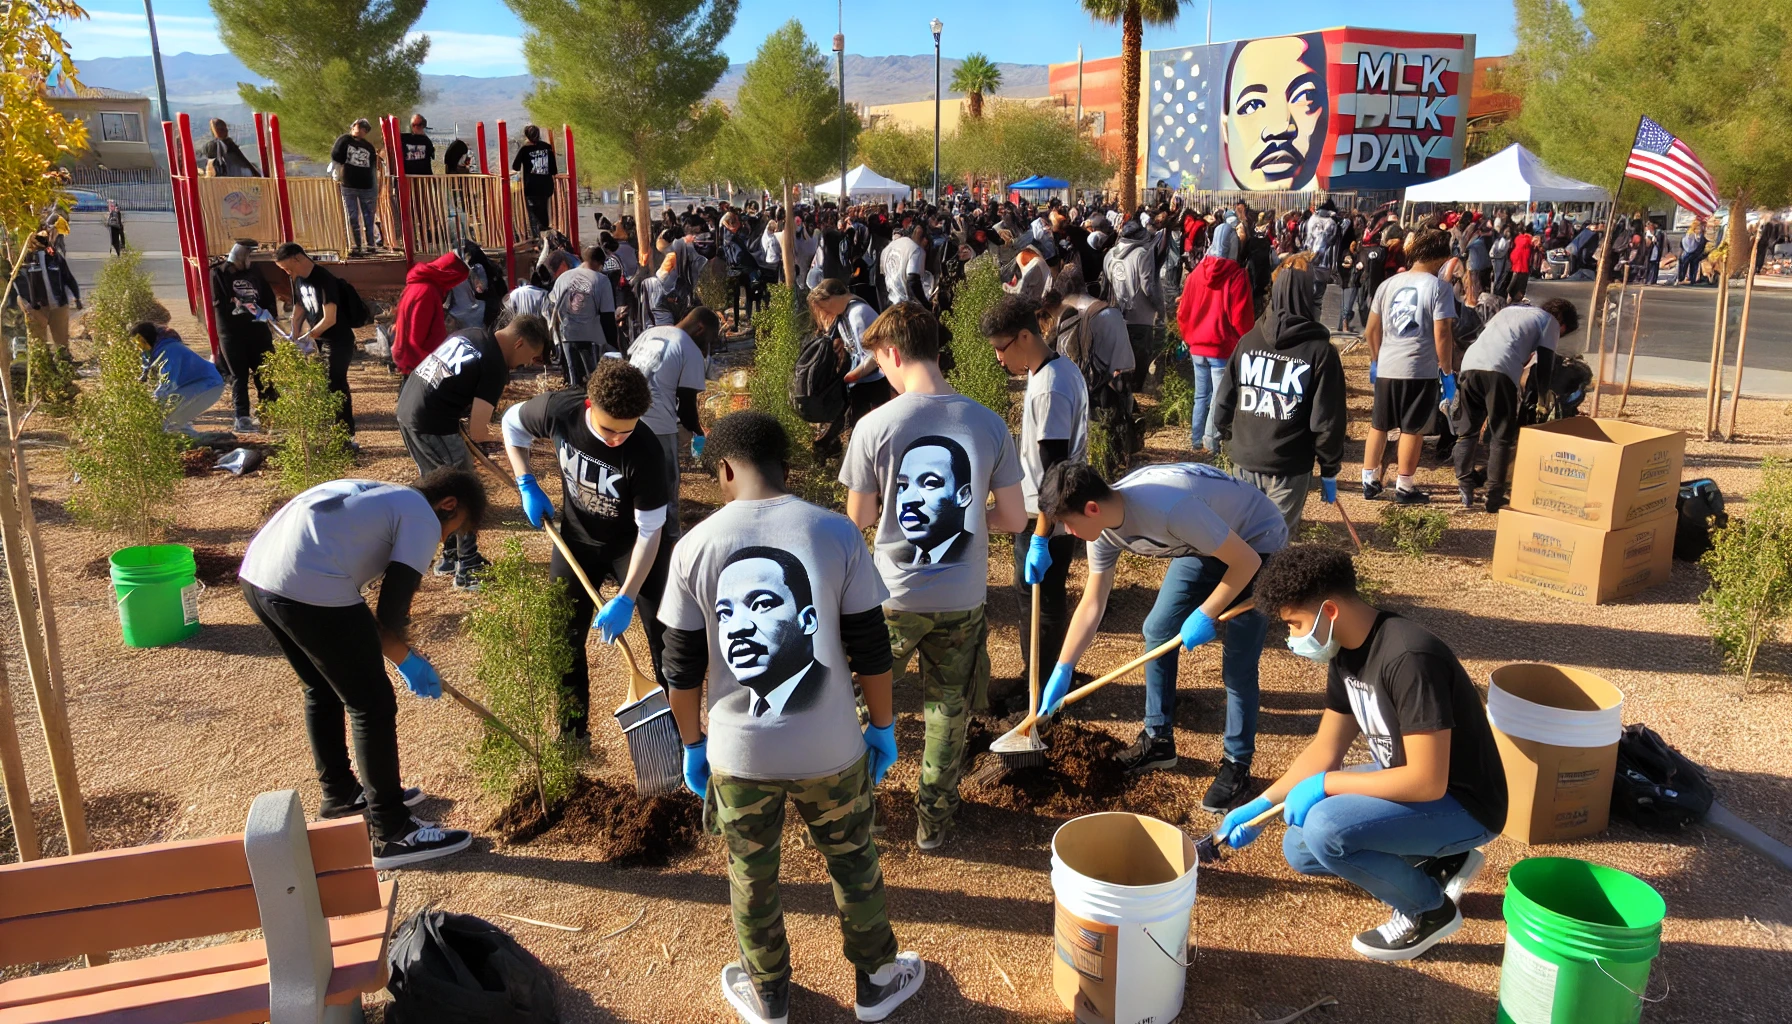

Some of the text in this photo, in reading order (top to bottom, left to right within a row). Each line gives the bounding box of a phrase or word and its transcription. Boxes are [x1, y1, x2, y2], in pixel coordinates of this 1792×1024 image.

[1356, 51, 1449, 94] MLK
[1348, 133, 1442, 174] DAY
[1240, 352, 1311, 395] MLK
[1240, 386, 1299, 420] DAY
